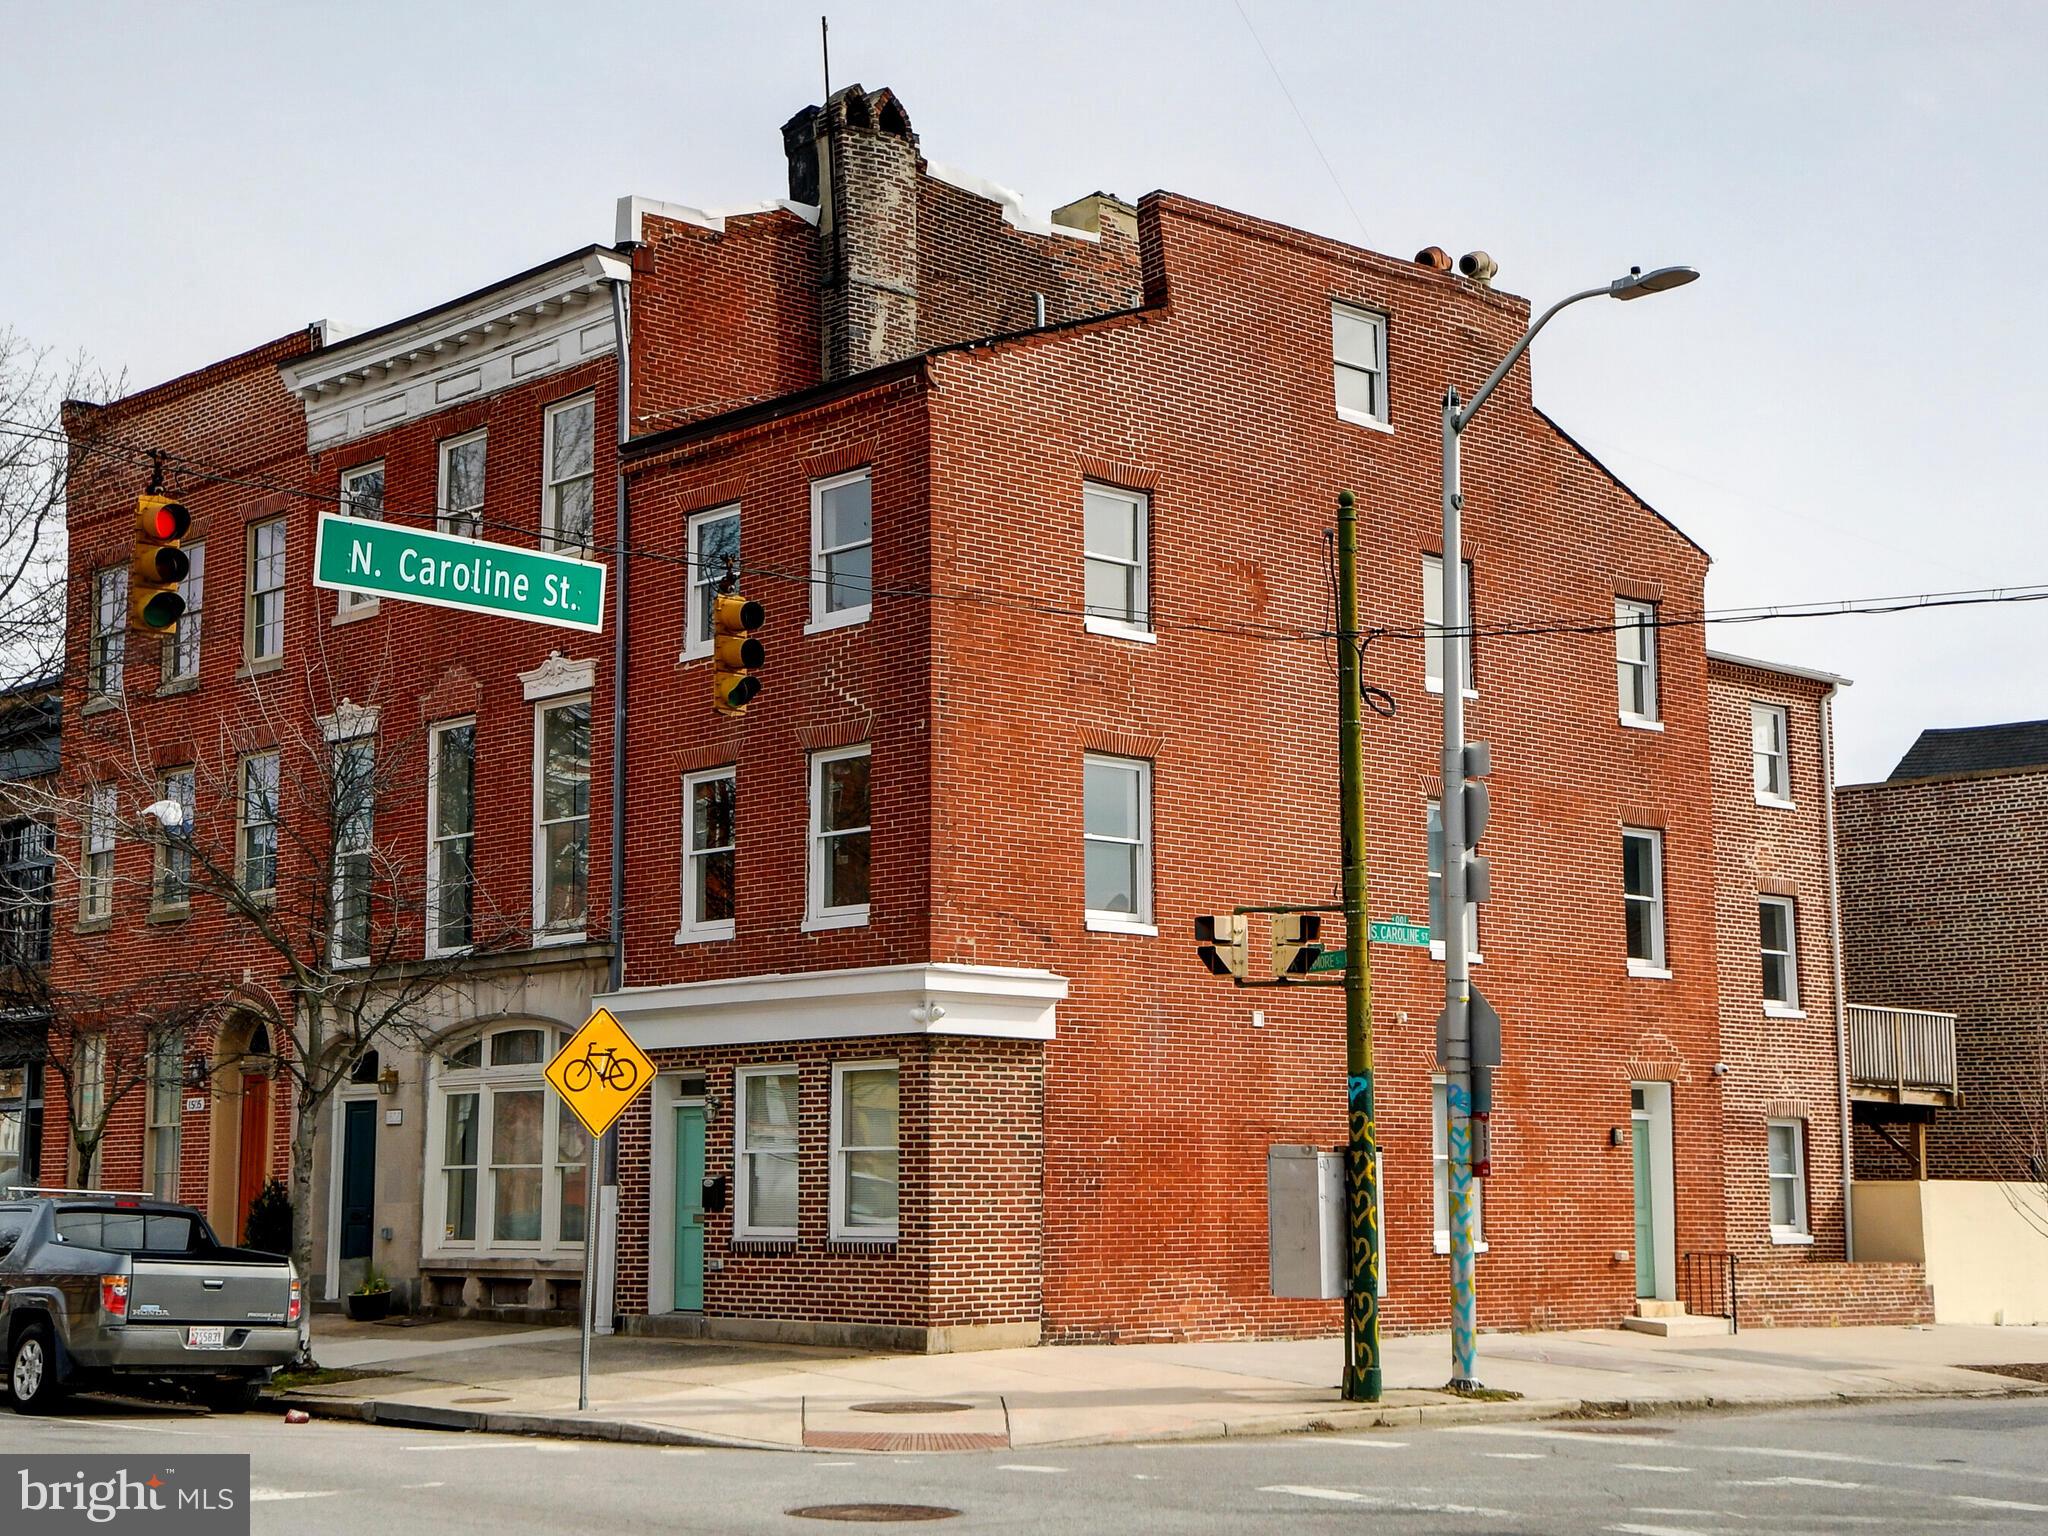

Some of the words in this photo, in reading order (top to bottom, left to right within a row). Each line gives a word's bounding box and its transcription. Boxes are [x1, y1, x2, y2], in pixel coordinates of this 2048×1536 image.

[351, 539, 381, 577] N.
[399, 548, 529, 602] Caroline
[543, 573, 577, 611] St.
[1371, 925, 1380, 939] S.
[1380, 925, 1420, 943] CAROLINE
